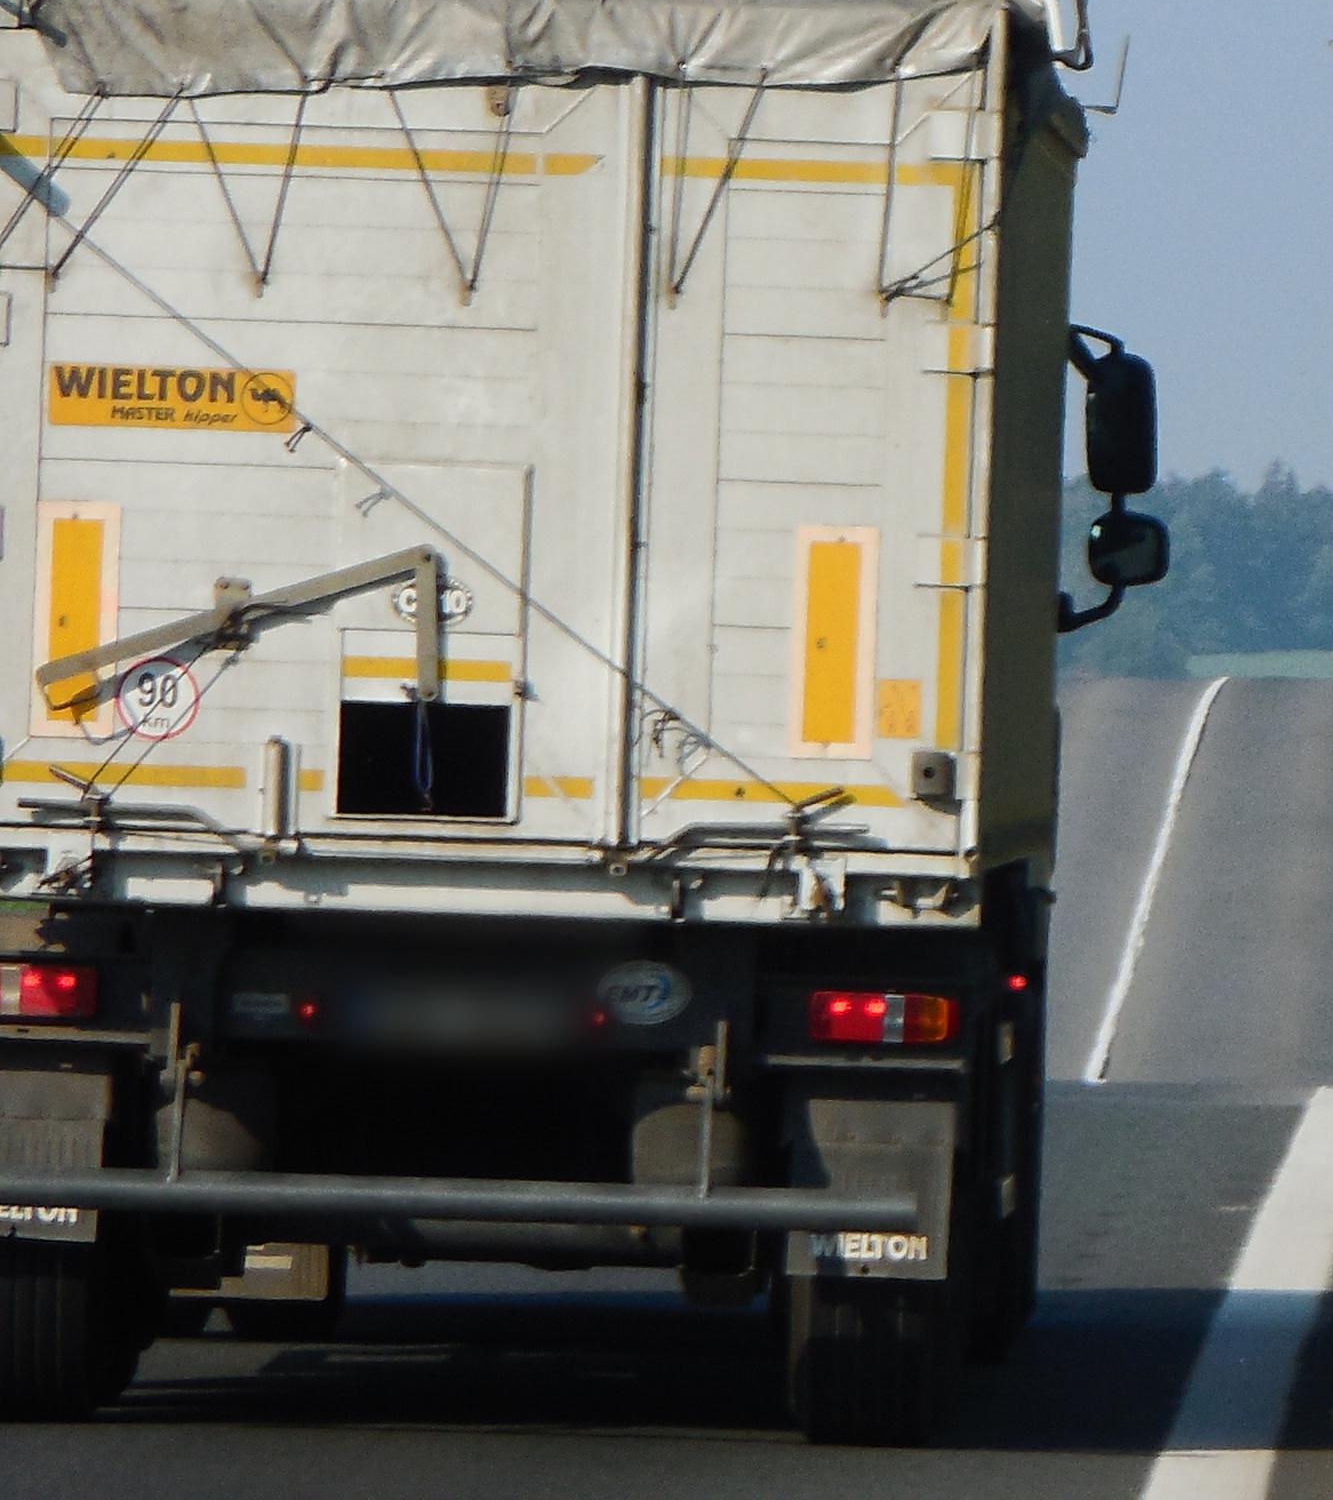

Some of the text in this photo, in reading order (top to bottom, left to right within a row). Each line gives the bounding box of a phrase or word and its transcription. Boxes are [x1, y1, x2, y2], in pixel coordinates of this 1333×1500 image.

[54, 366, 236, 404] WIELTON
[111, 405, 176, 423] MASTER
[138, 672, 178, 709] 90
